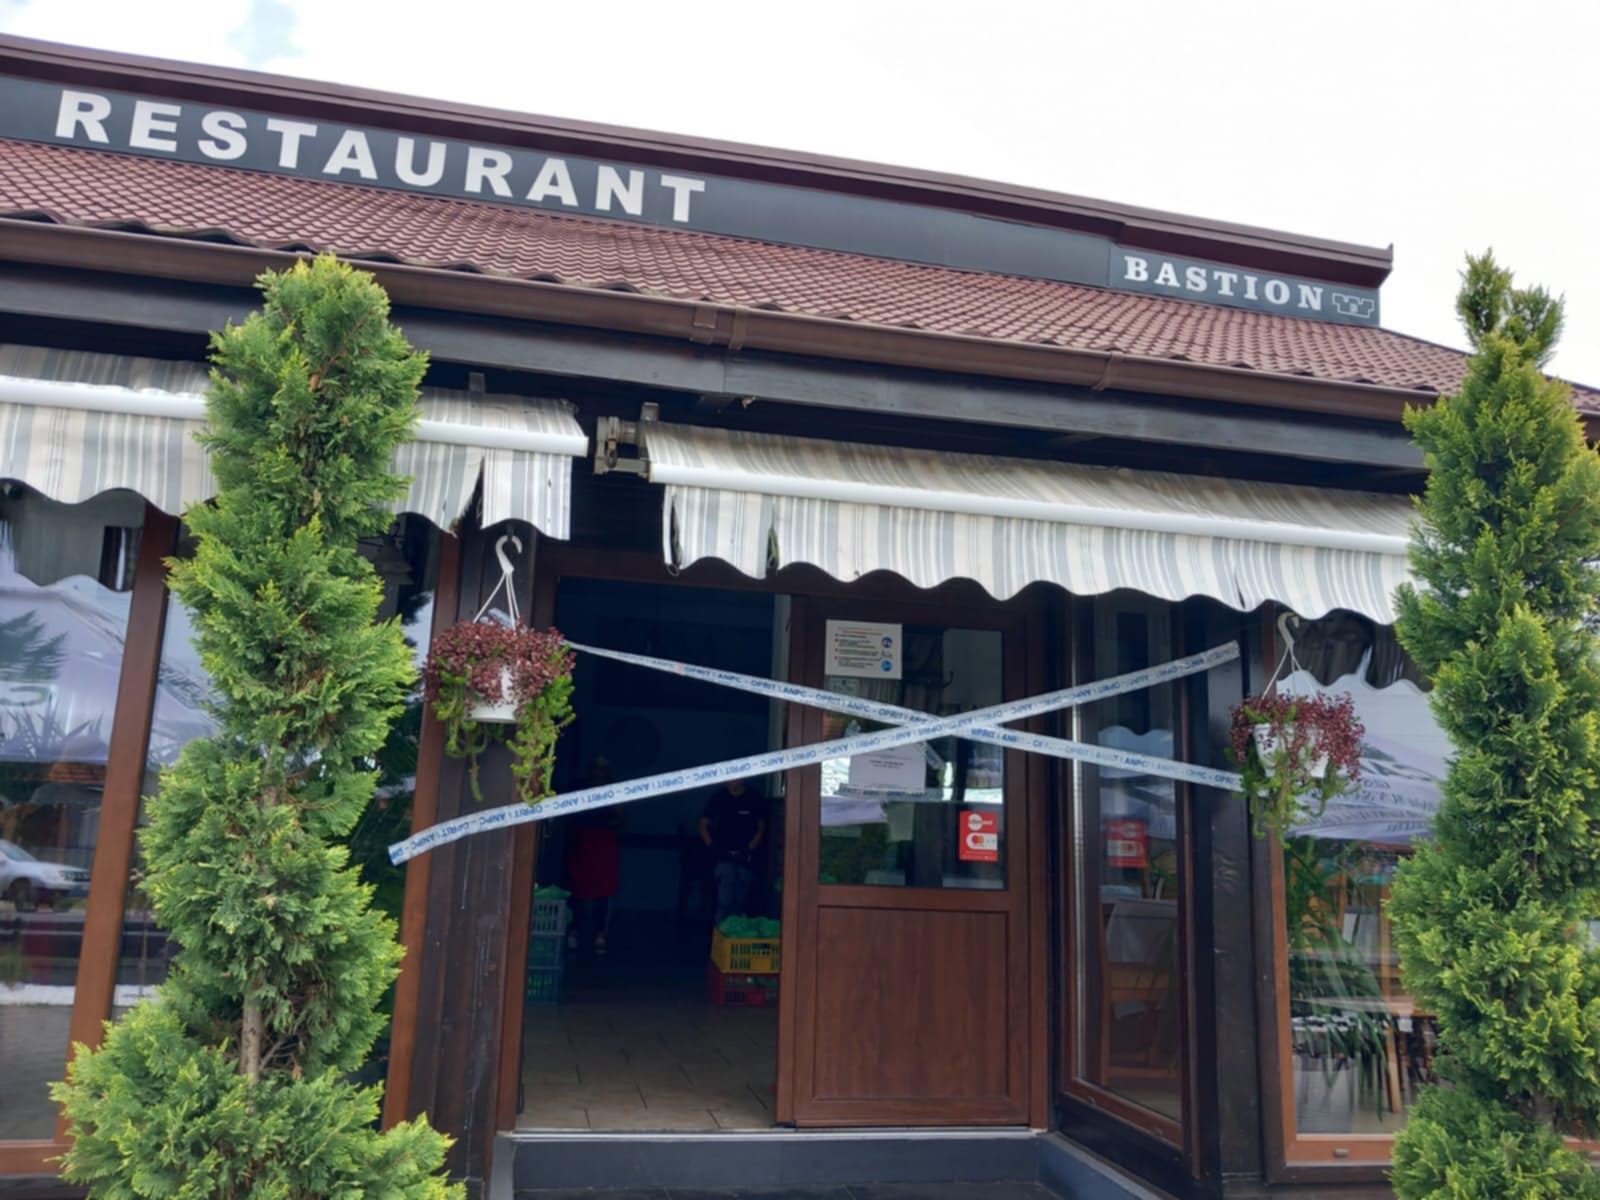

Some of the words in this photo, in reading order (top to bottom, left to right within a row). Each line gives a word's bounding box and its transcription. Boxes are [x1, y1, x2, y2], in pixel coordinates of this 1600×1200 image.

[54, 89, 706, 223] RESTAURANT
[1123, 255, 1324, 311] BASTION
[751, 679, 777, 691] OPRIT
[783, 687, 807, 699] ANPC
[847, 701, 870, 713] ANPC
[879, 707, 906, 720] OPRIT
[1124, 757, 1147, 768] ANPC
[791, 751, 816, 761] OPRIT
[826, 744, 849, 755] ANPC
[725, 762, 752, 775] OPRIT
[761, 757, 784, 768] ANPC
[694, 769, 717, 781] ANPC
[657, 776, 684, 789] OPRIT
[624, 784, 650, 795] ANPC
[588, 790, 615, 803] OPRIT
[554, 797, 579, 810] ANPC
[514, 806, 543, 819] OPRIT
[480, 814, 505, 825] ANPC
[440, 823, 470, 837] OPRIT
[411, 834, 436, 850] ANPC
